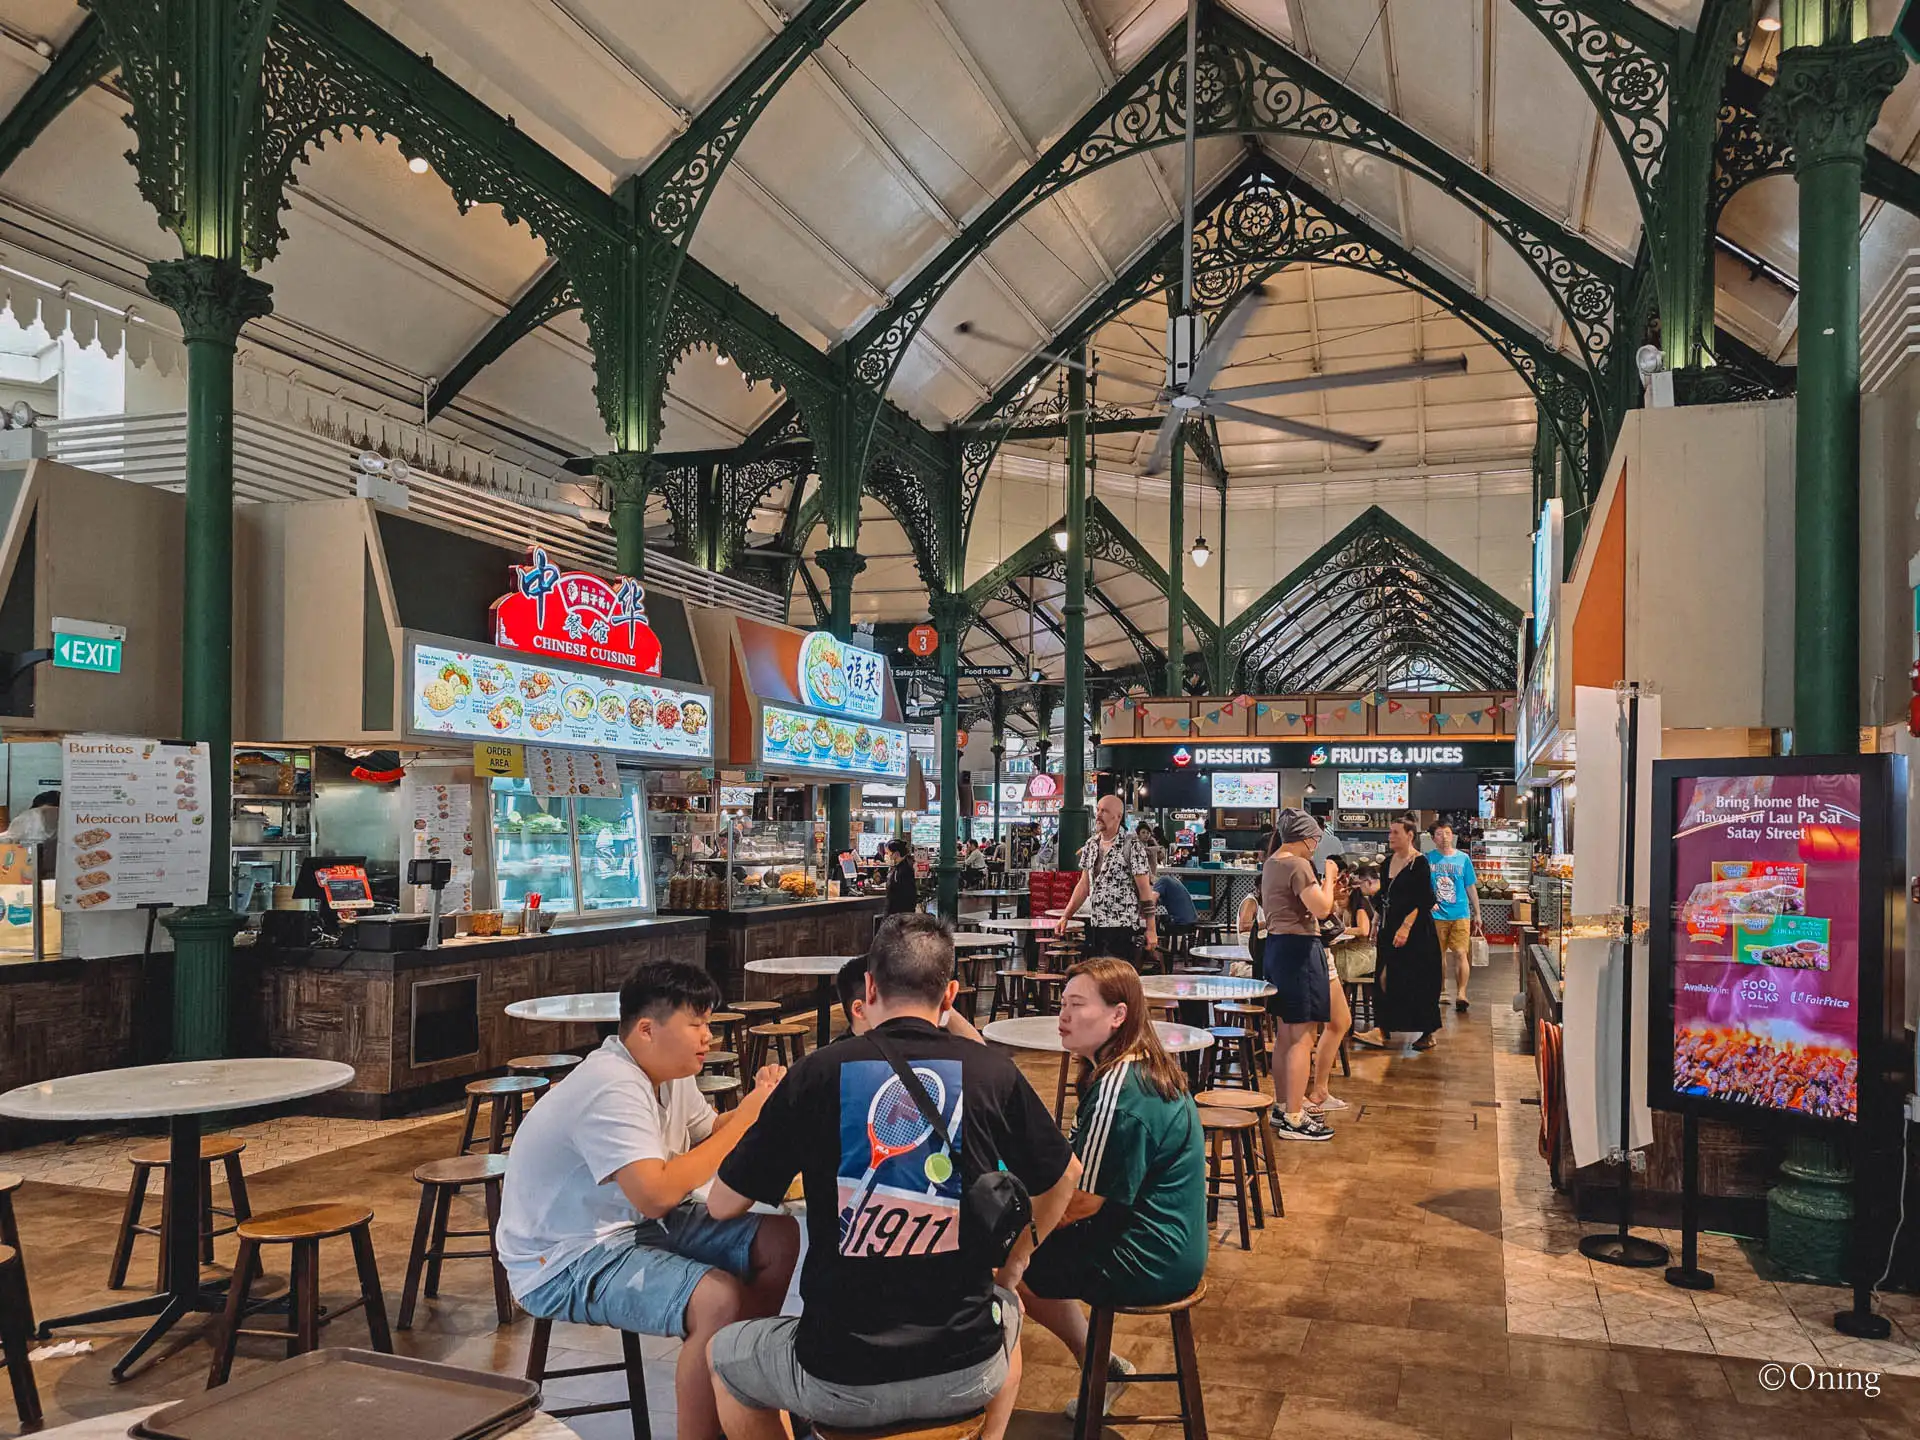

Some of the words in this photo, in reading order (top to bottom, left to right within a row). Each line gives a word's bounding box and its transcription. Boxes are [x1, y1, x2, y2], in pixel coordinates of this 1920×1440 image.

[518, 547, 559, 630] 中
[611, 577, 648, 649] 华
[920, 636, 927, 650] 3
[72, 640, 116, 667] EXIT
[533, 636, 588, 657] CHINESE
[590, 649, 636, 666] CUISINE
[895, 669, 914, 677] Satay
[69, 742, 134, 754] Burritos
[487, 746, 512, 756] ORDER
[1331, 747, 1389, 763] FRUITS
[1390, 747, 1403, 763] &
[1404, 747, 1463, 763] JUICES
[1195, 748, 1271, 764] DESSERTS
[490, 759, 509, 768] AREA
[1716, 796, 1750, 811] Bring
[1754, 795, 1794, 808] home
[1797, 795, 1819, 808] the
[76, 813, 140, 824] Mexican
[145, 813, 178, 823] Bowl
[1697, 811, 1746, 825] flavours
[1751, 811, 1765, 825] of
[1770, 811, 1793, 825] Lau
[1798, 811, 1815, 825] Pa
[1819, 811, 1842, 825] Sat
[1727, 827, 1762, 843] Satay
[1766, 827, 1806, 841] Street
[1684, 983, 1718, 994] Available
[1741, 979, 1777, 991] FOOD
[1740, 990, 1780, 1003] FOLKS
[1805, 994, 1850, 1009] FairPrice
[852, 1204, 953, 1258] 1911
